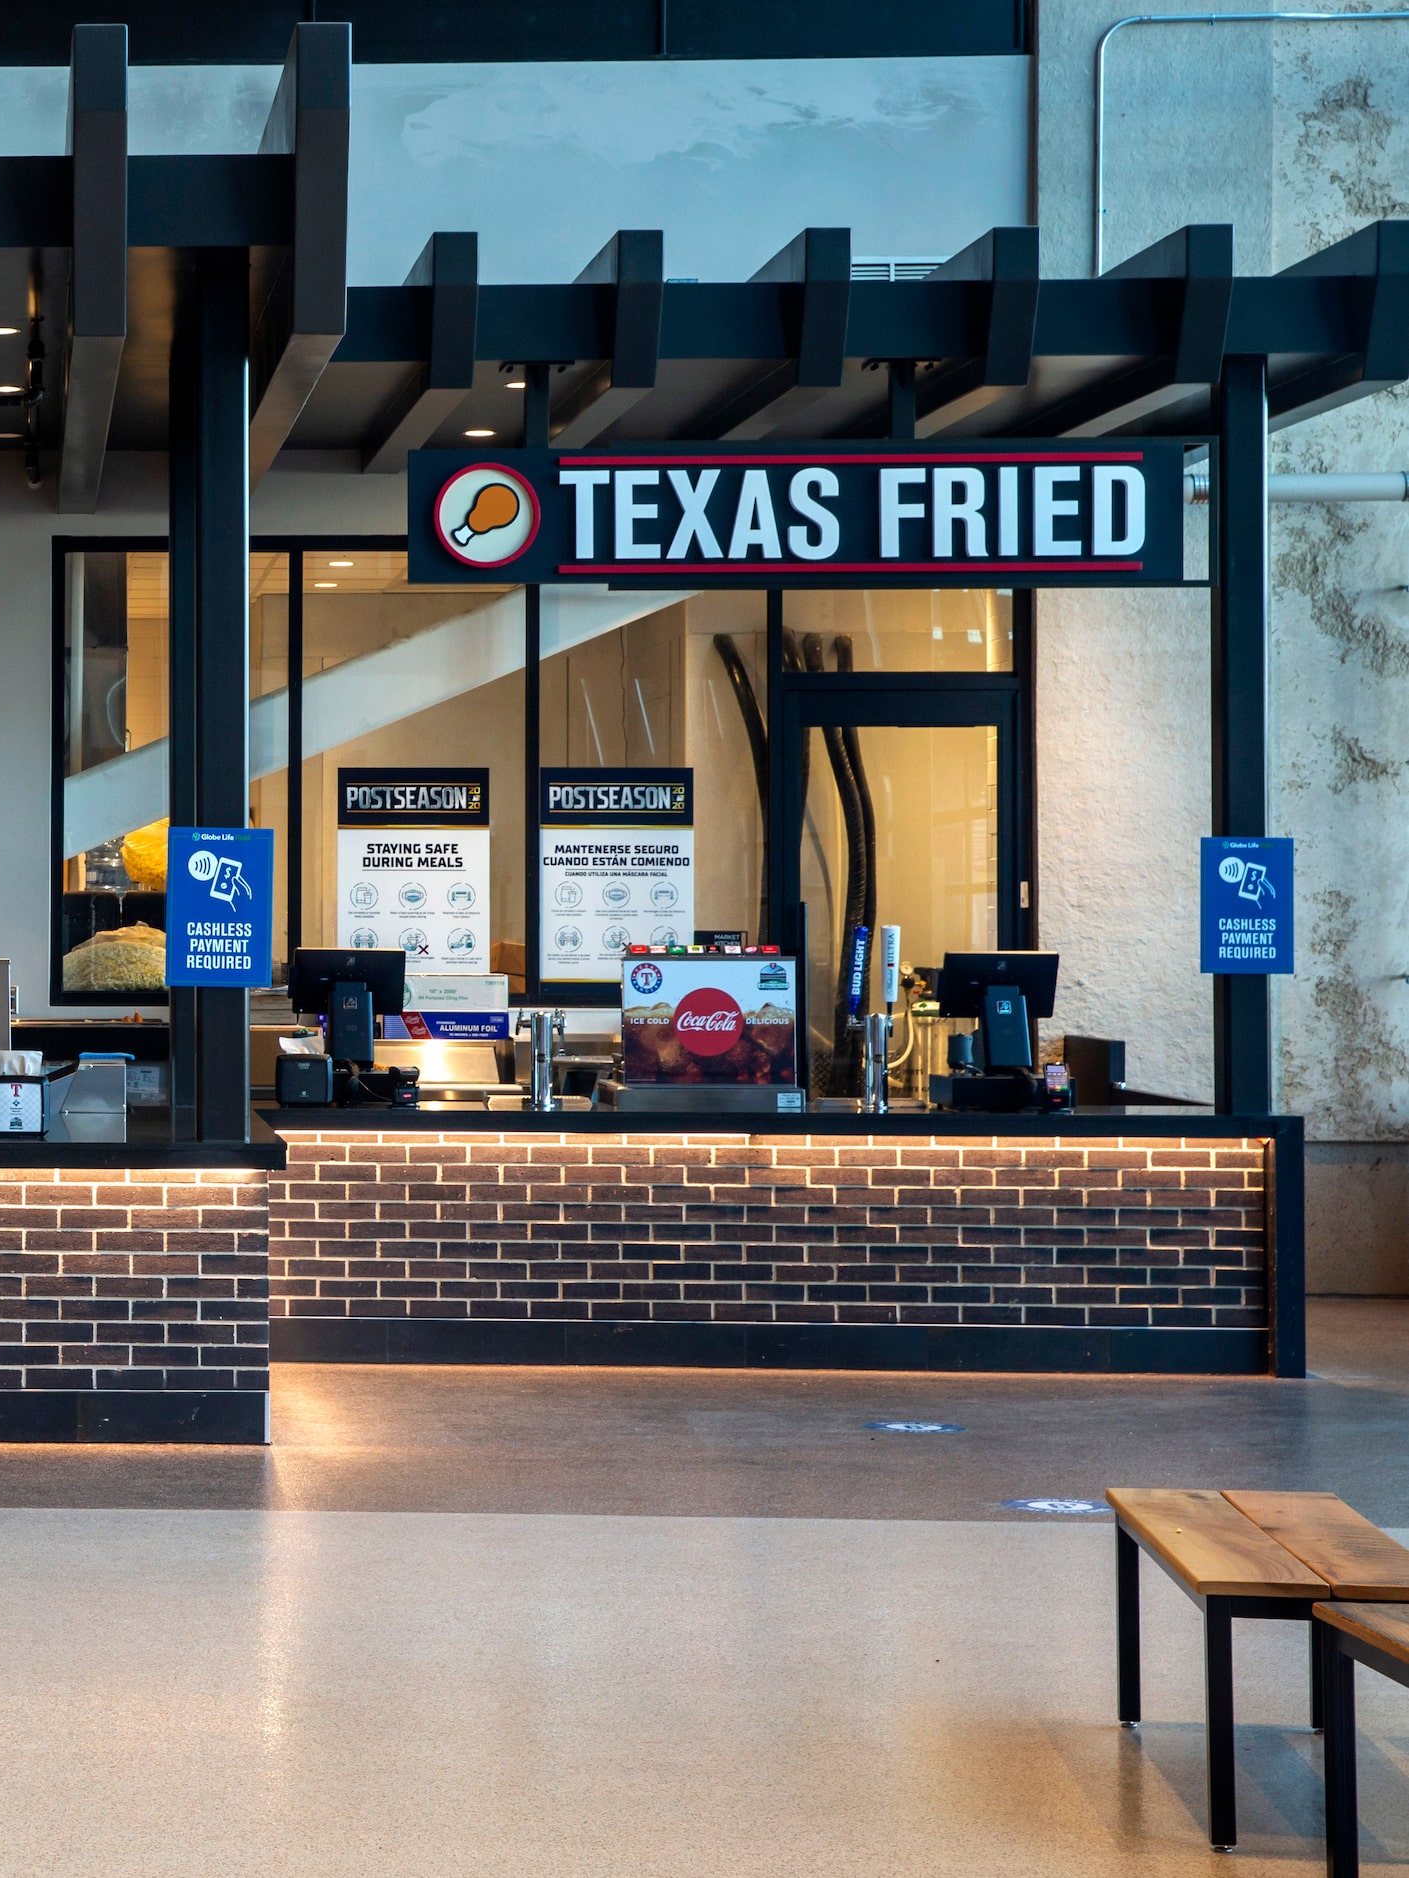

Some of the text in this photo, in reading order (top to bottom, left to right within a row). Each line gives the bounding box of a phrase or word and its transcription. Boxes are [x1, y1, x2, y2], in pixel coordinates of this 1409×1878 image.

[559, 465, 1146, 560] TEXAS FRIED
[468, 786, 481, 795] 20
[672, 786, 685, 795] 20
[346, 786, 467, 810] POSTSEASON
[549, 786, 671, 810] POSTSEASON
[468, 801, 481, 810] 20
[672, 801, 685, 810] 20
[201, 833, 221, 841] Globe
[222, 833, 235, 841] Life
[367, 843, 459, 854] STAYING SAFE
[554, 845, 679, 855] MANTENERSE SEGURO
[362, 857, 463, 868] DURING MEALS
[543, 854, 690, 867] CUANDO ESTÁN COMIENDO
[187, 922, 252, 937] CASHLESS
[1219, 918, 1276, 931] CASHLESS
[190, 938, 249, 953] PAYMENT
[1221, 933, 1274, 945] PAYMENT
[887, 933, 895, 962] ULTRA
[1219, 946, 1277, 959] REQUIRED
[186, 955, 252, 970] REQUIRED
[851, 939, 865, 995] BUD LIGHT
[641, 972, 653, 986] T
[676, 1010, 740, 1031] Coca-Cola
[10, 1083, 23, 1097] T
